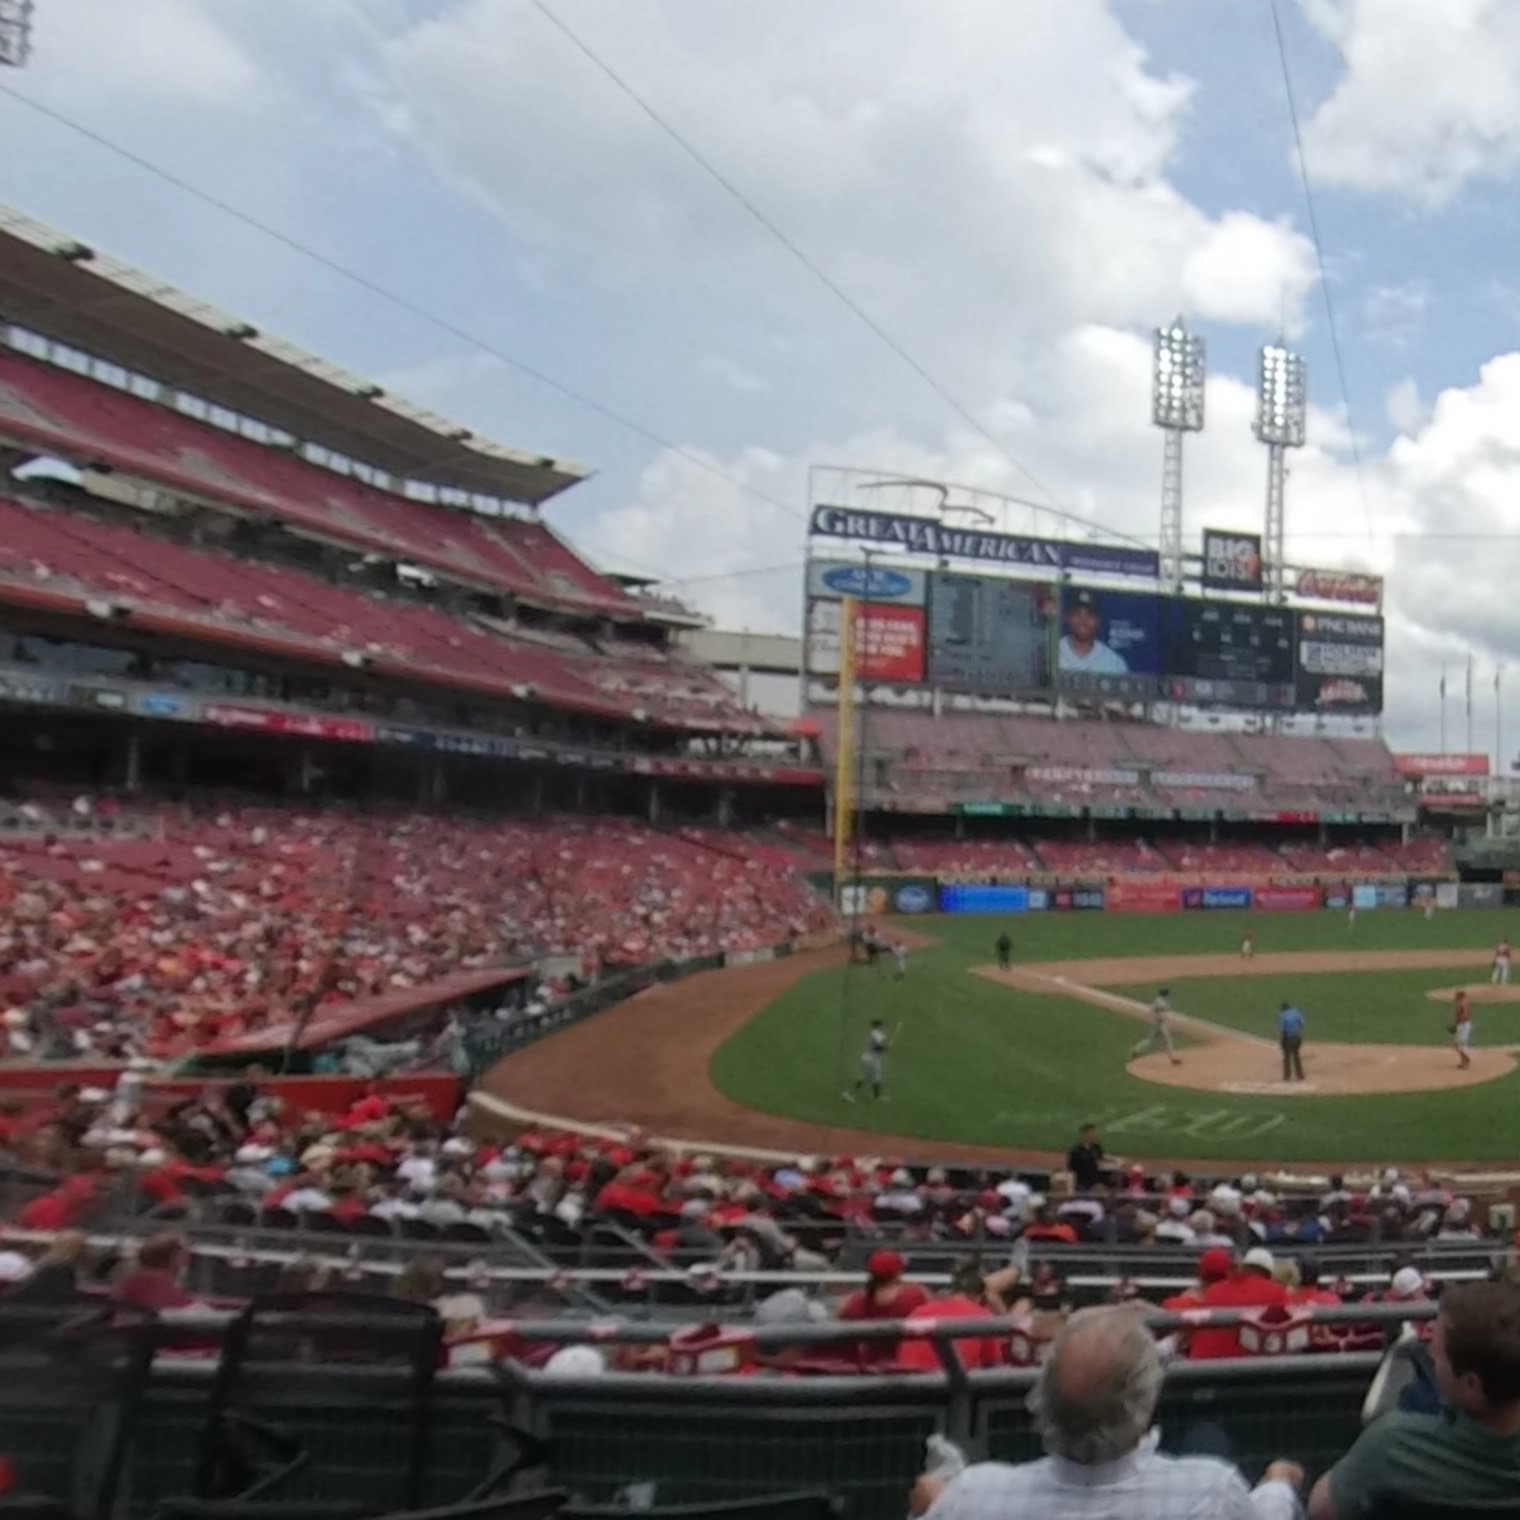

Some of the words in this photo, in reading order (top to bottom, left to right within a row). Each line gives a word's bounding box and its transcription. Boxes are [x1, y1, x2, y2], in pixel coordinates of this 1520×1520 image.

[816, 508, 924, 543] GREAT
[911, 526, 1063, 568] AMERICAN
[1207, 537, 1255, 560] BIG
